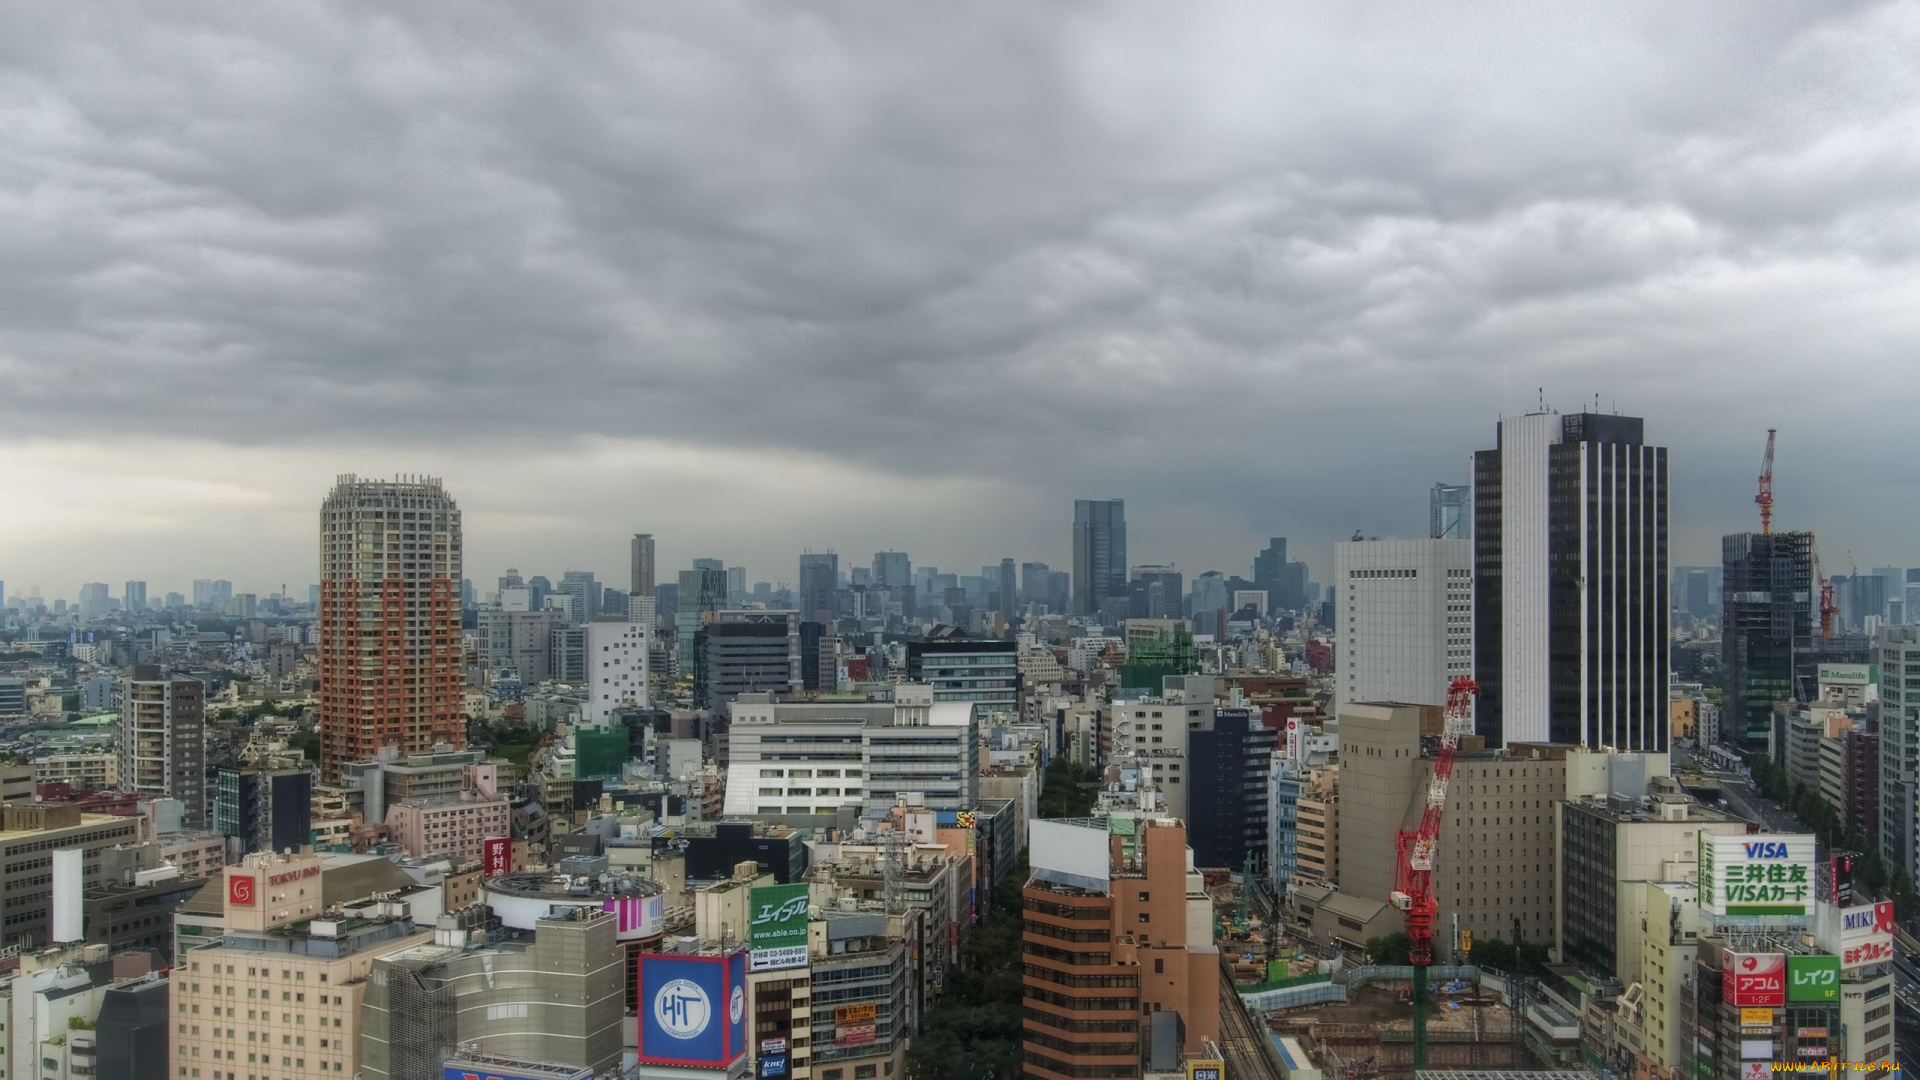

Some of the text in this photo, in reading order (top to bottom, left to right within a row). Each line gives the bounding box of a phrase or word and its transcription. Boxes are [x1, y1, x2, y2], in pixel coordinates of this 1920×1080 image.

[1831, 671, 1866, 679] Manulife
[1742, 843, 1788, 858] VISA
[269, 865, 320, 886] TOKYU INN
[1726, 864, 1808, 883] 三井住友
[1726, 885, 1809, 902] VISAカード
[751, 895, 809, 925] エイブル
[1844, 910, 1874, 930] MIKI
[753, 928, 807, 940] www.able.co.jp
[1740, 977, 1780, 991] アコム
[1794, 970, 1836, 985] レイク
